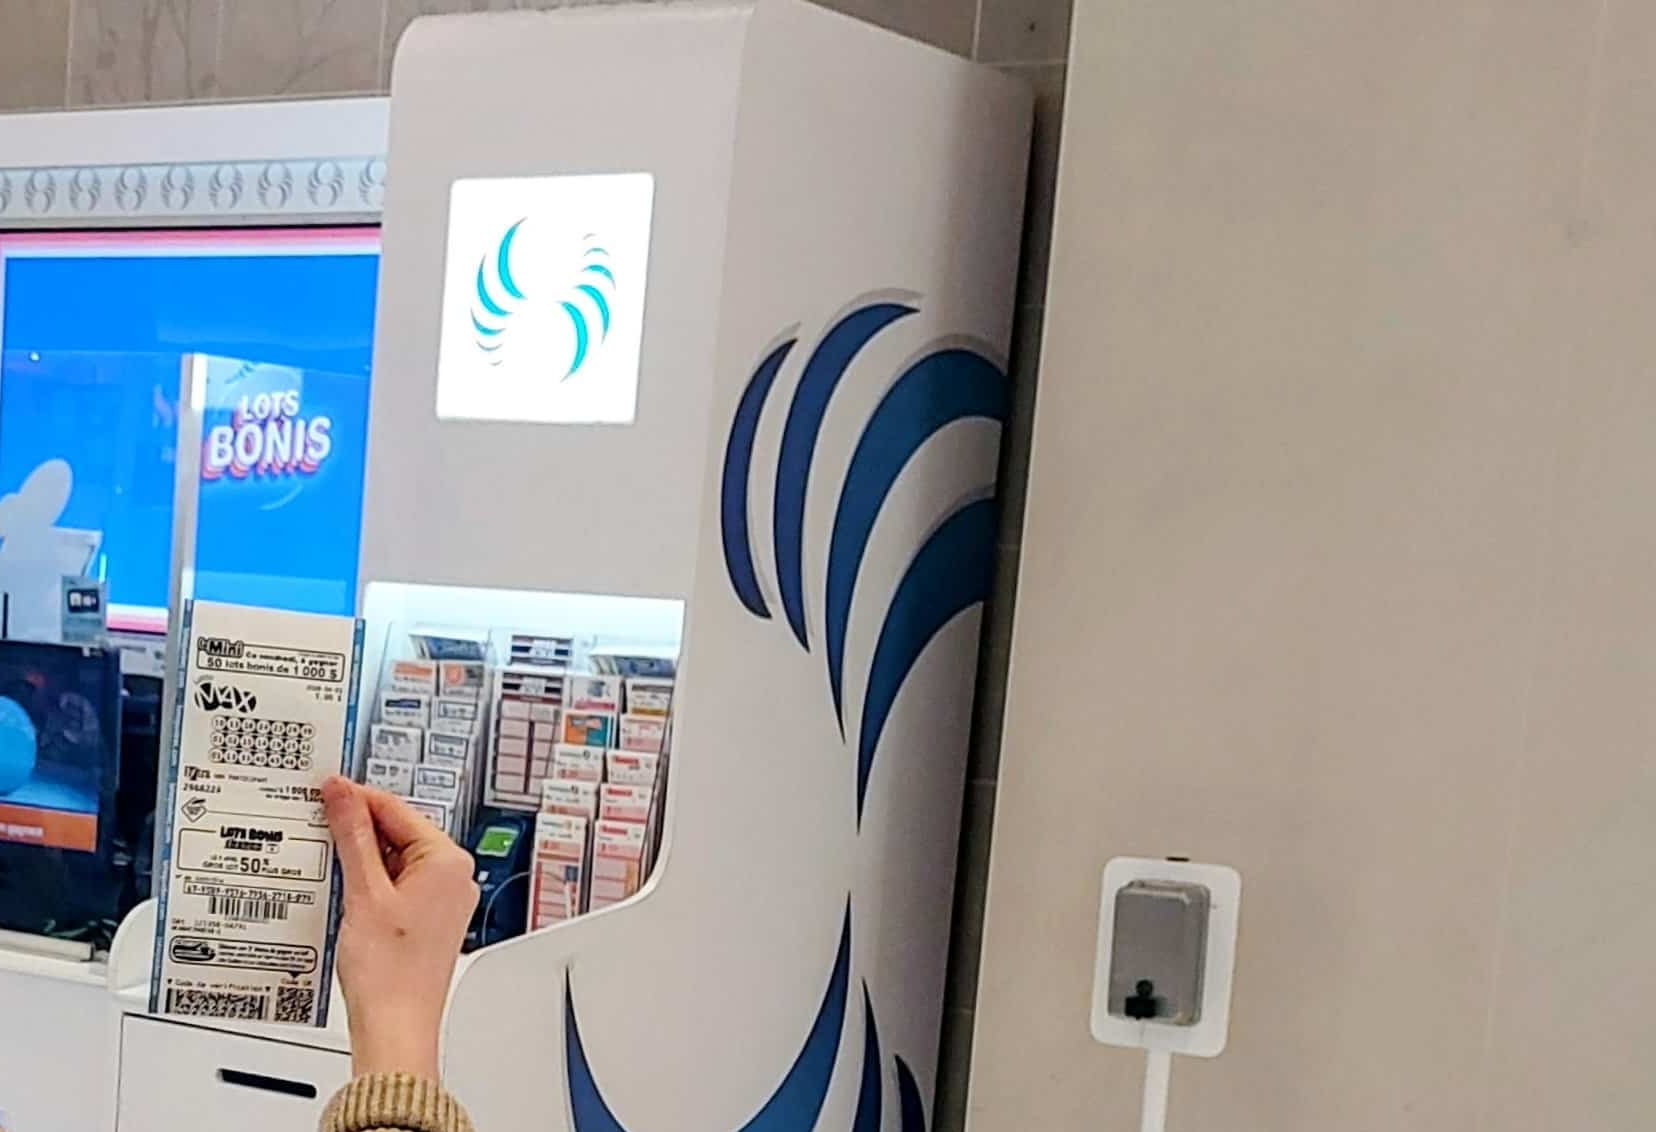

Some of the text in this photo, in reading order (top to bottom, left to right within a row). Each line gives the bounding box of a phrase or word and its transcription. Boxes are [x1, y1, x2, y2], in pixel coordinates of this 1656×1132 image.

[239, 390, 300, 421] LOTS
[207, 416, 333, 473] BONIS
[208, 640, 242, 657] Mini
[207, 657, 222, 668] 50
[225, 658, 244, 670] lots
[246, 661, 274, 672] bonis
[302, 666, 326, 678] 000
[194, 681, 257, 713] MAX
[239, 856, 261, 874] 50
